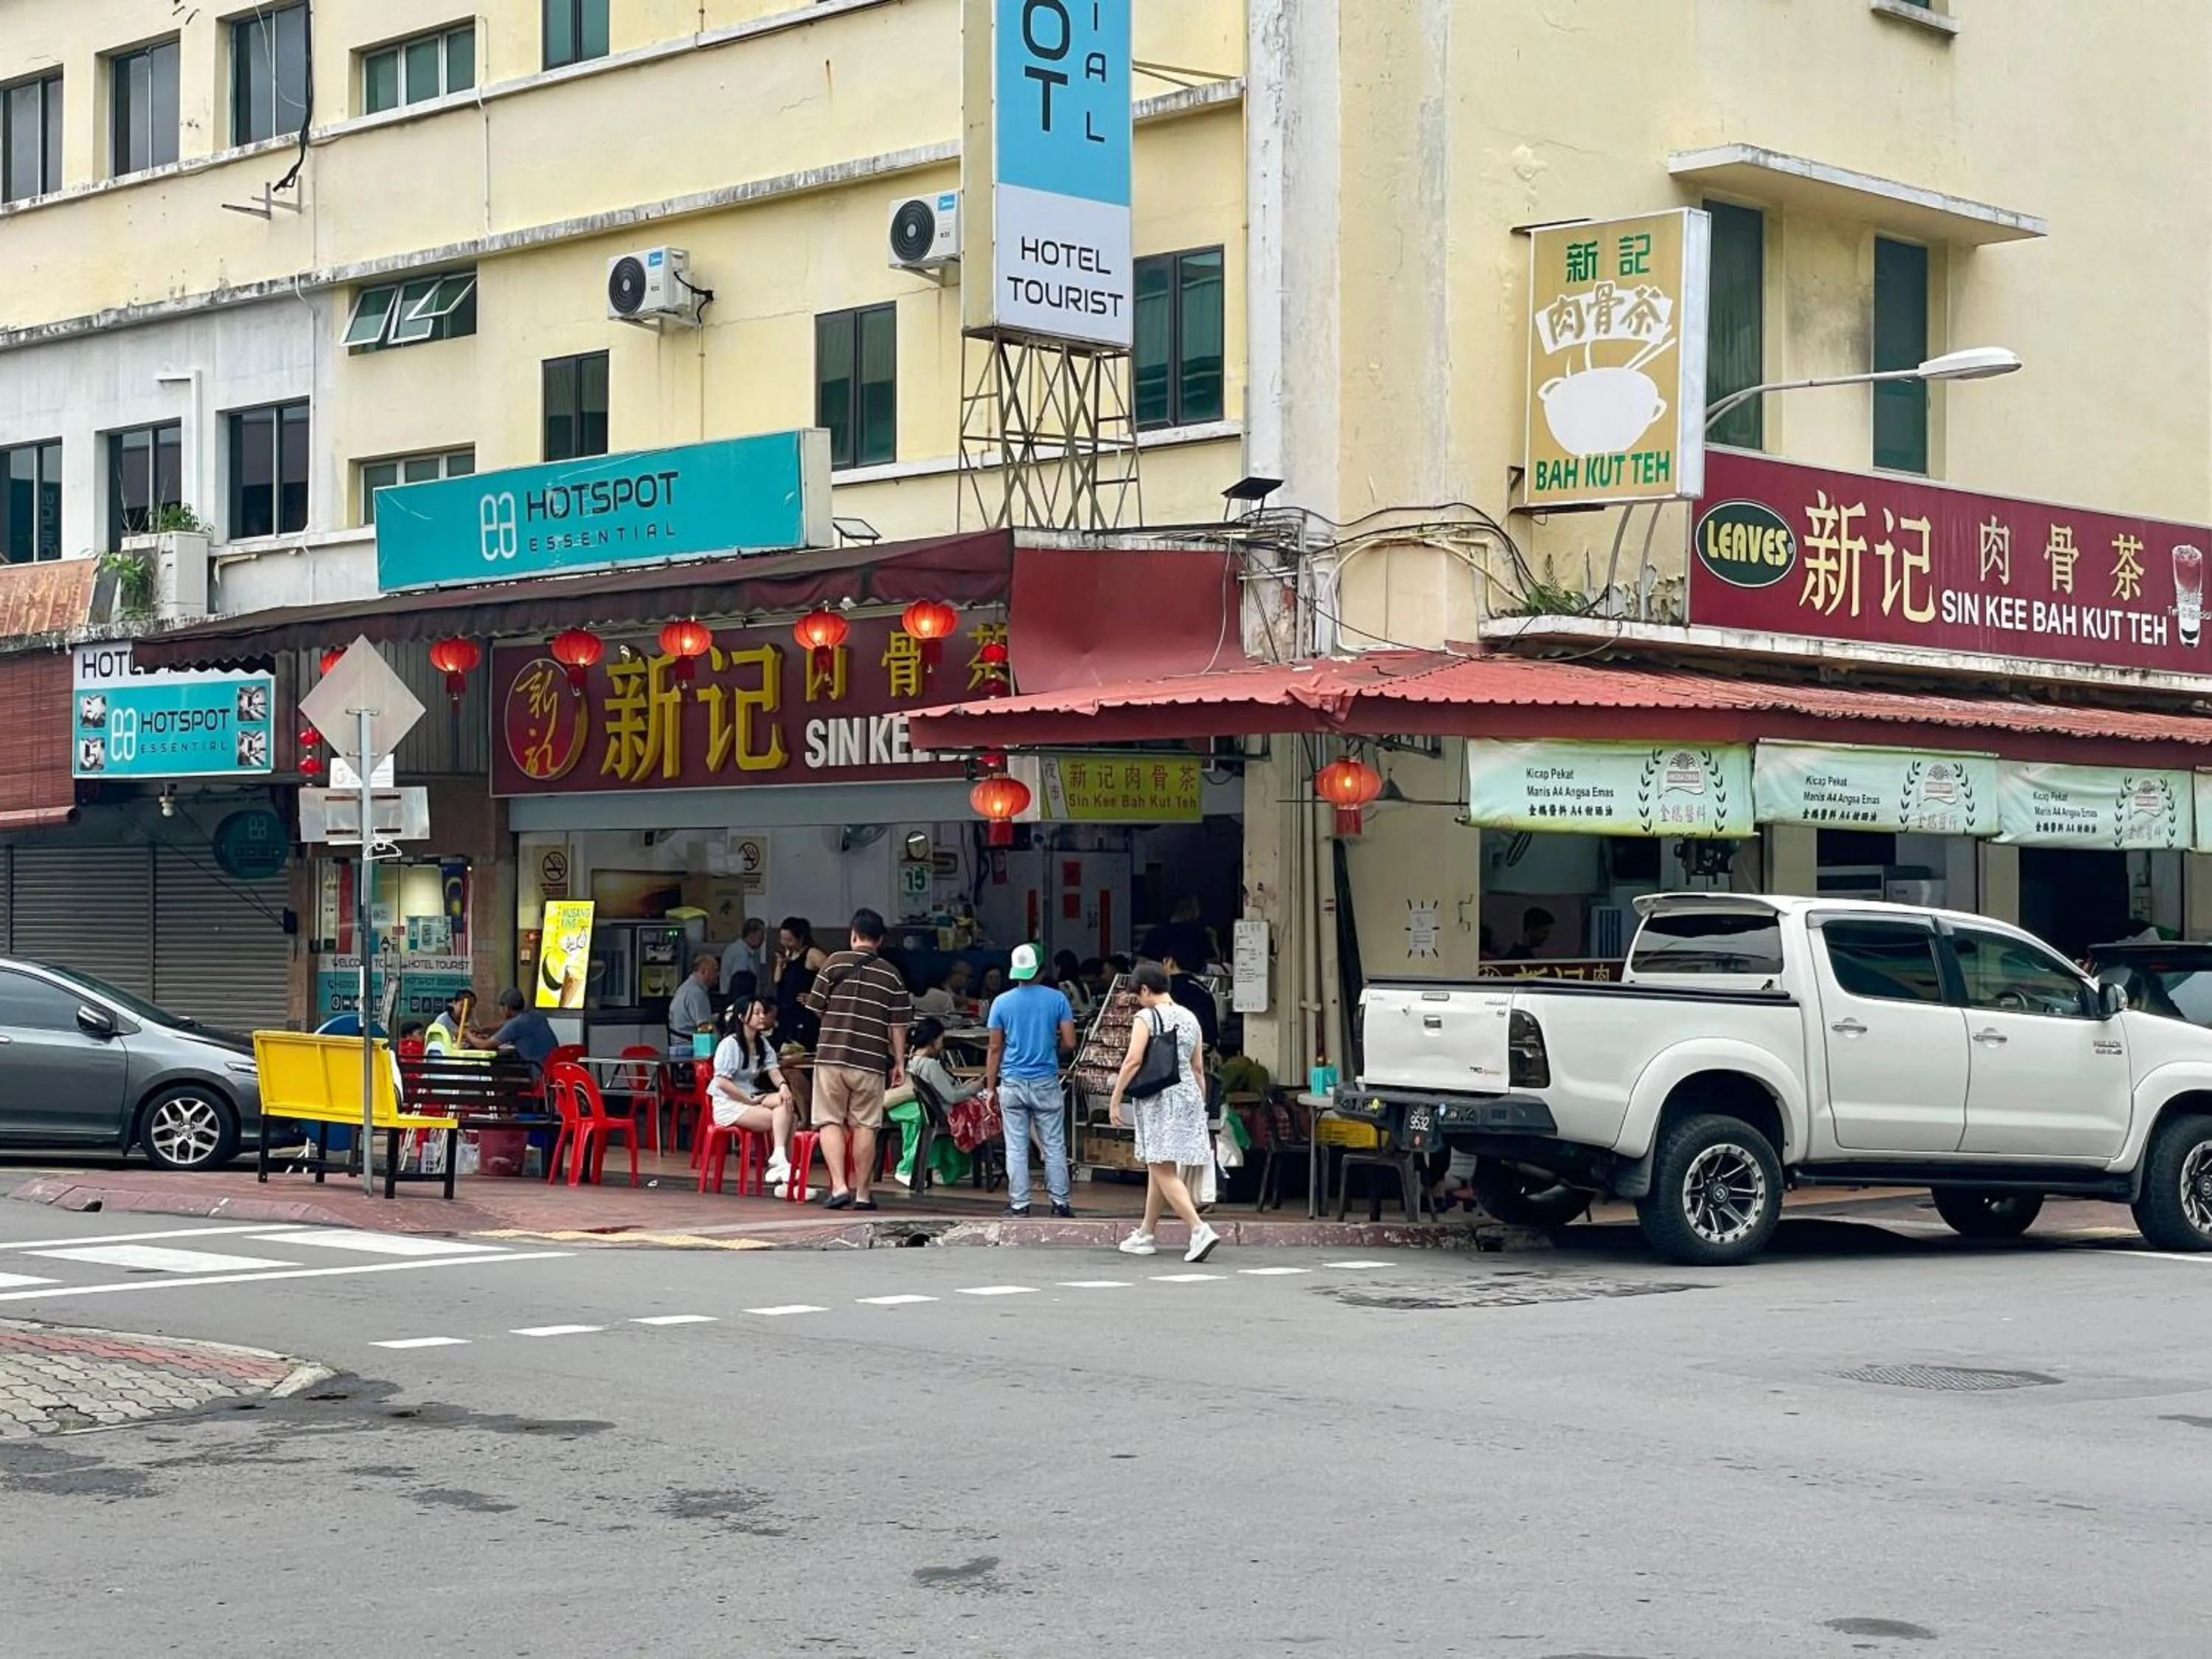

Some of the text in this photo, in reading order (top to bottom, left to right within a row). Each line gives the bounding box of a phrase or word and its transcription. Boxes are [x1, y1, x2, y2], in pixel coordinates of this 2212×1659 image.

[1021, 236, 1111, 275] HOTEL
[1565, 234, 1651, 283] 新記
[1007, 276, 1124, 317] TOURIST
[1547, 282, 1663, 344] 肉骨茶
[1534, 451, 1670, 490] BAH KUT TEH
[526, 471, 679, 522] HOTSPOT
[529, 524, 675, 552] ESSENTIAL
[1706, 520, 1788, 566] LEAVES
[1799, 489, 2146, 623] 新记 肉骨茶
[1941, 589, 1975, 625] SIN
[1985, 595, 2028, 632] KEE
[2032, 600, 2079, 636] BAH
[2082, 607, 2124, 641] KUT
[2126, 611, 2167, 646] TEH
[141, 708, 231, 733] HOTSPOT
[599, 641, 790, 782] 新记
[141, 741, 227, 754] ESSENTIAL
[804, 717, 867, 769] SIN
[1068, 764, 1196, 792] 新记肉骨茶
[1526, 768, 1574, 780] Kicap Pekat
[1527, 786, 1614, 799] Manis A4 Angsa Emas
[1068, 793, 1197, 808] Sin Kee Bah Kut Teh
[408, 959, 434, 970] HOTEL
[436, 960, 469, 970] TOURIST
[1410, 1116, 1430, 1131] 9532
